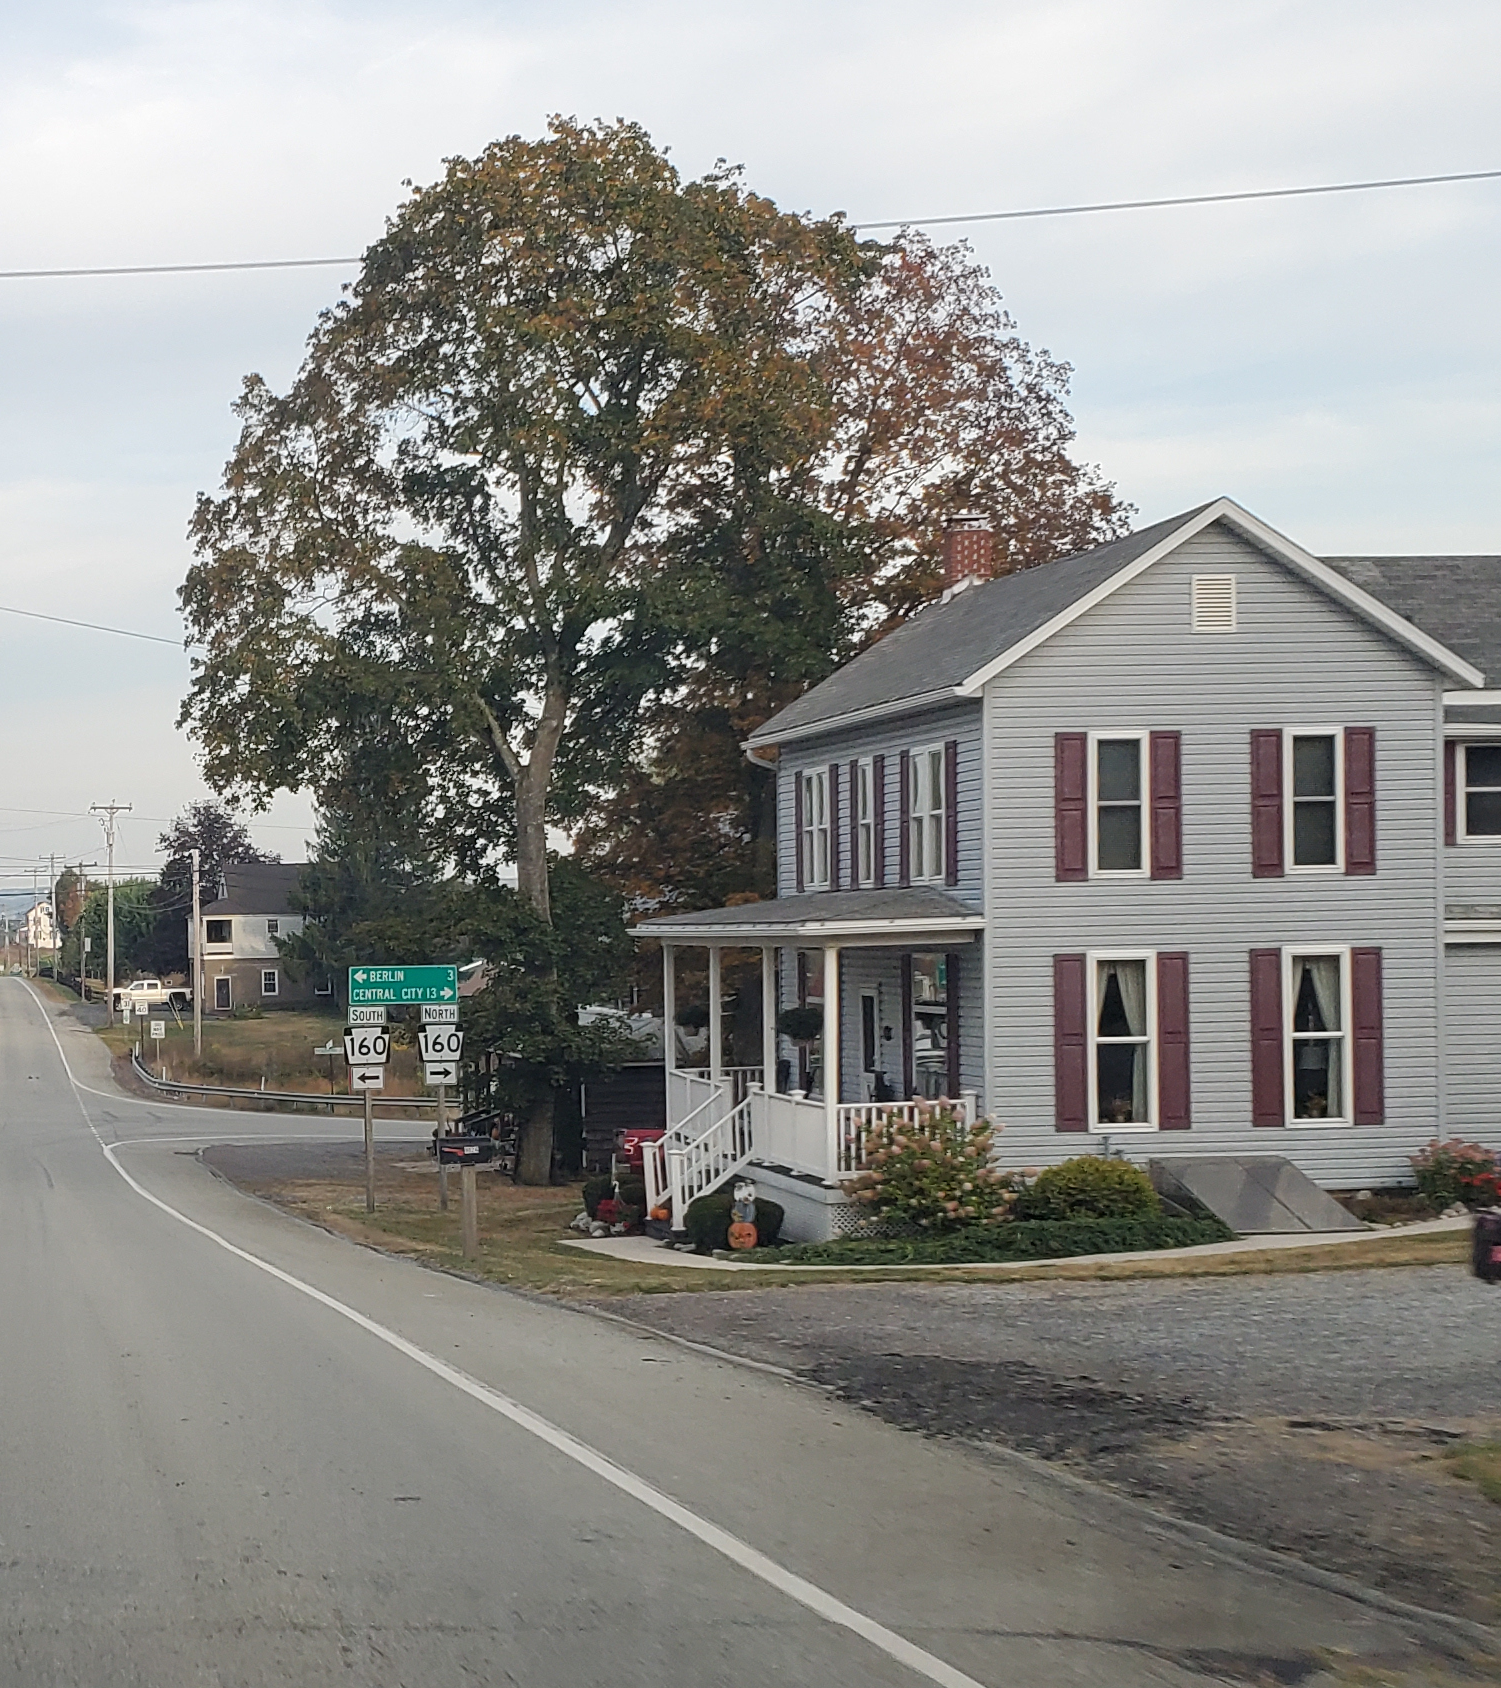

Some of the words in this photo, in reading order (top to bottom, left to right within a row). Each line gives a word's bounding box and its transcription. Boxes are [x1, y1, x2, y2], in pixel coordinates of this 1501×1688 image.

[369, 970, 404, 982] BERLIN
[446, 969, 454, 981] 3
[353, 988, 397, 1001] CENTRAL
[401, 987, 424, 1000] CITY
[426, 987, 437, 1000] 13
[349, 1035, 387, 1057] 160
[423, 1033, 461, 1054] 160
